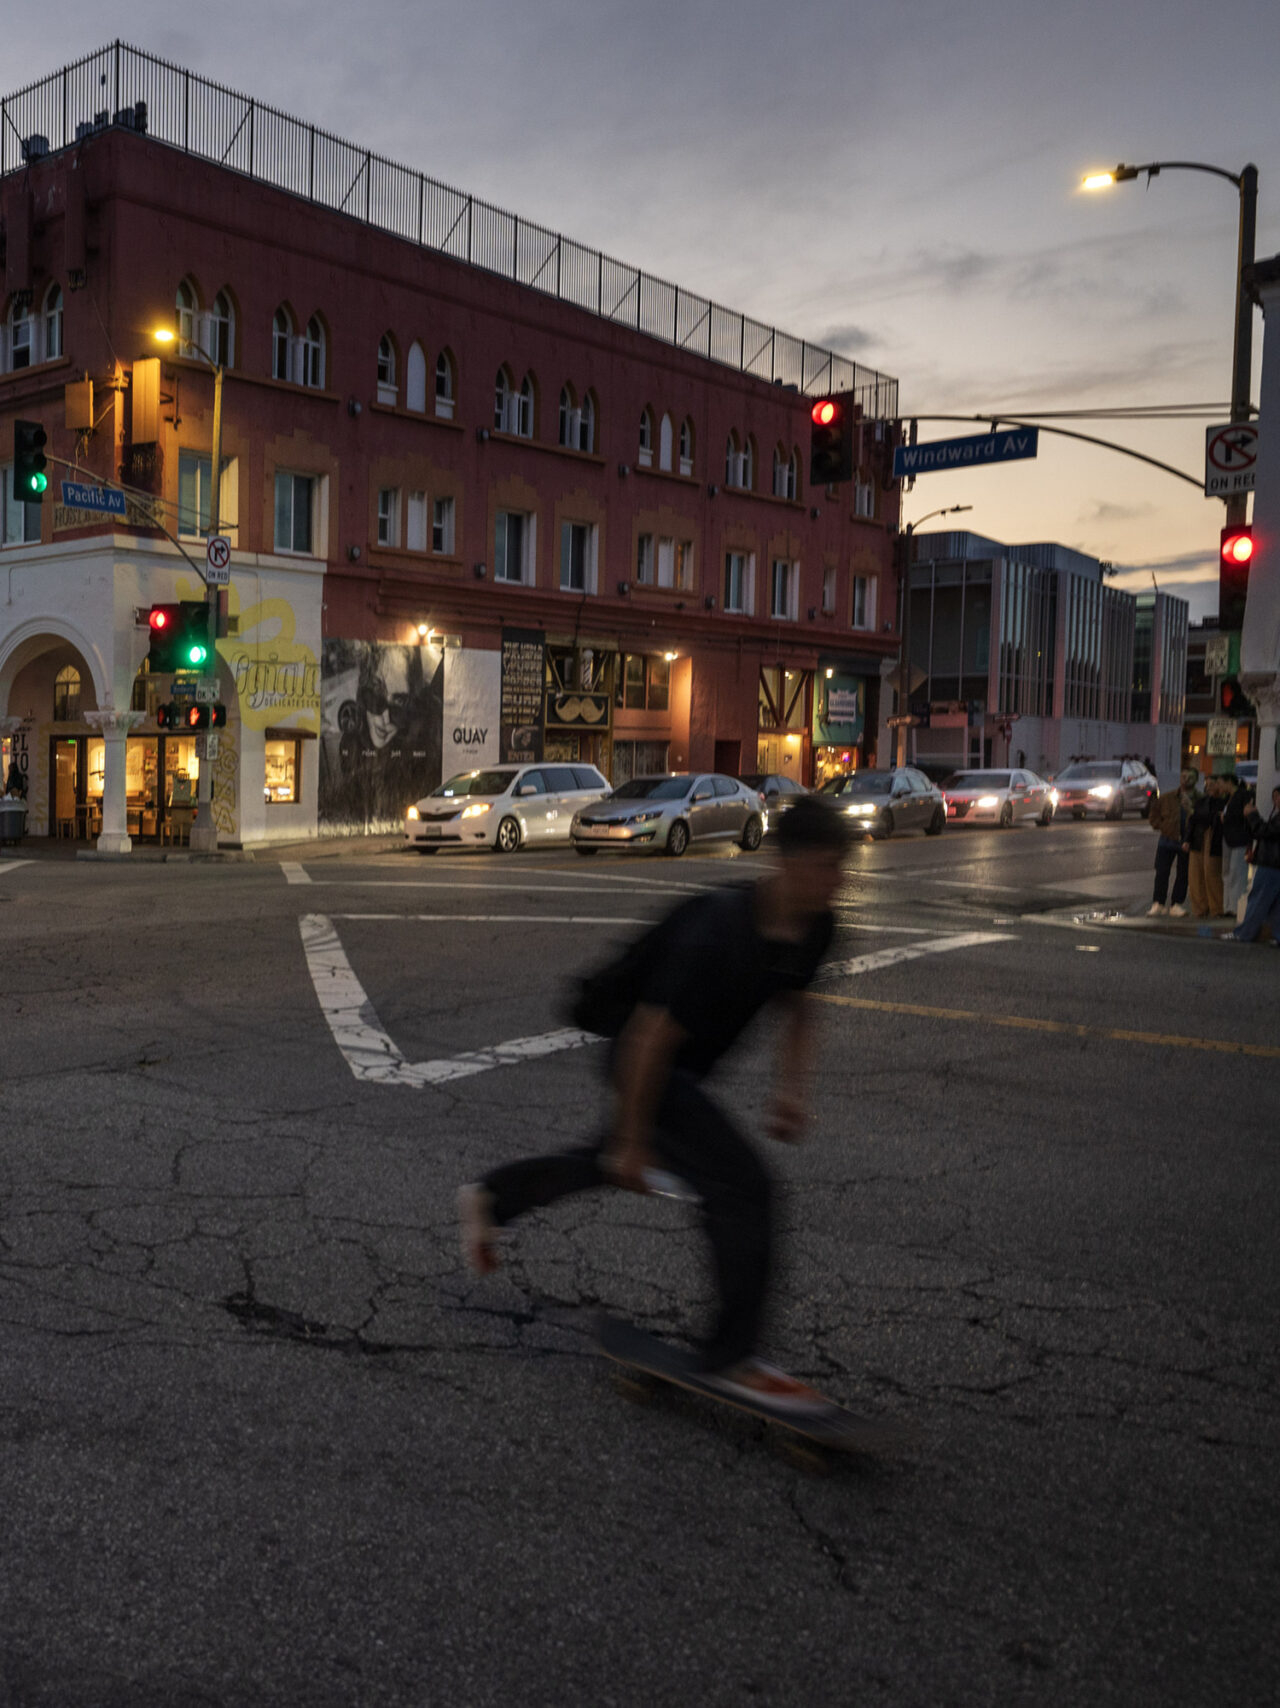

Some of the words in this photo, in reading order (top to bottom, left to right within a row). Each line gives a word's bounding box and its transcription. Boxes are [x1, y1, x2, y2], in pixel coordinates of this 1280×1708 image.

[903, 437, 996, 468] Windward
[1002, 434, 1027, 453] Av
[1210, 475, 1228, 492] ON
[67, 487, 106, 506] Pacific
[109, 494, 121, 508] Av
[207, 571, 216, 580] ON
[217, 572, 228, 581] RED
[453, 728, 489, 745] QUAY
